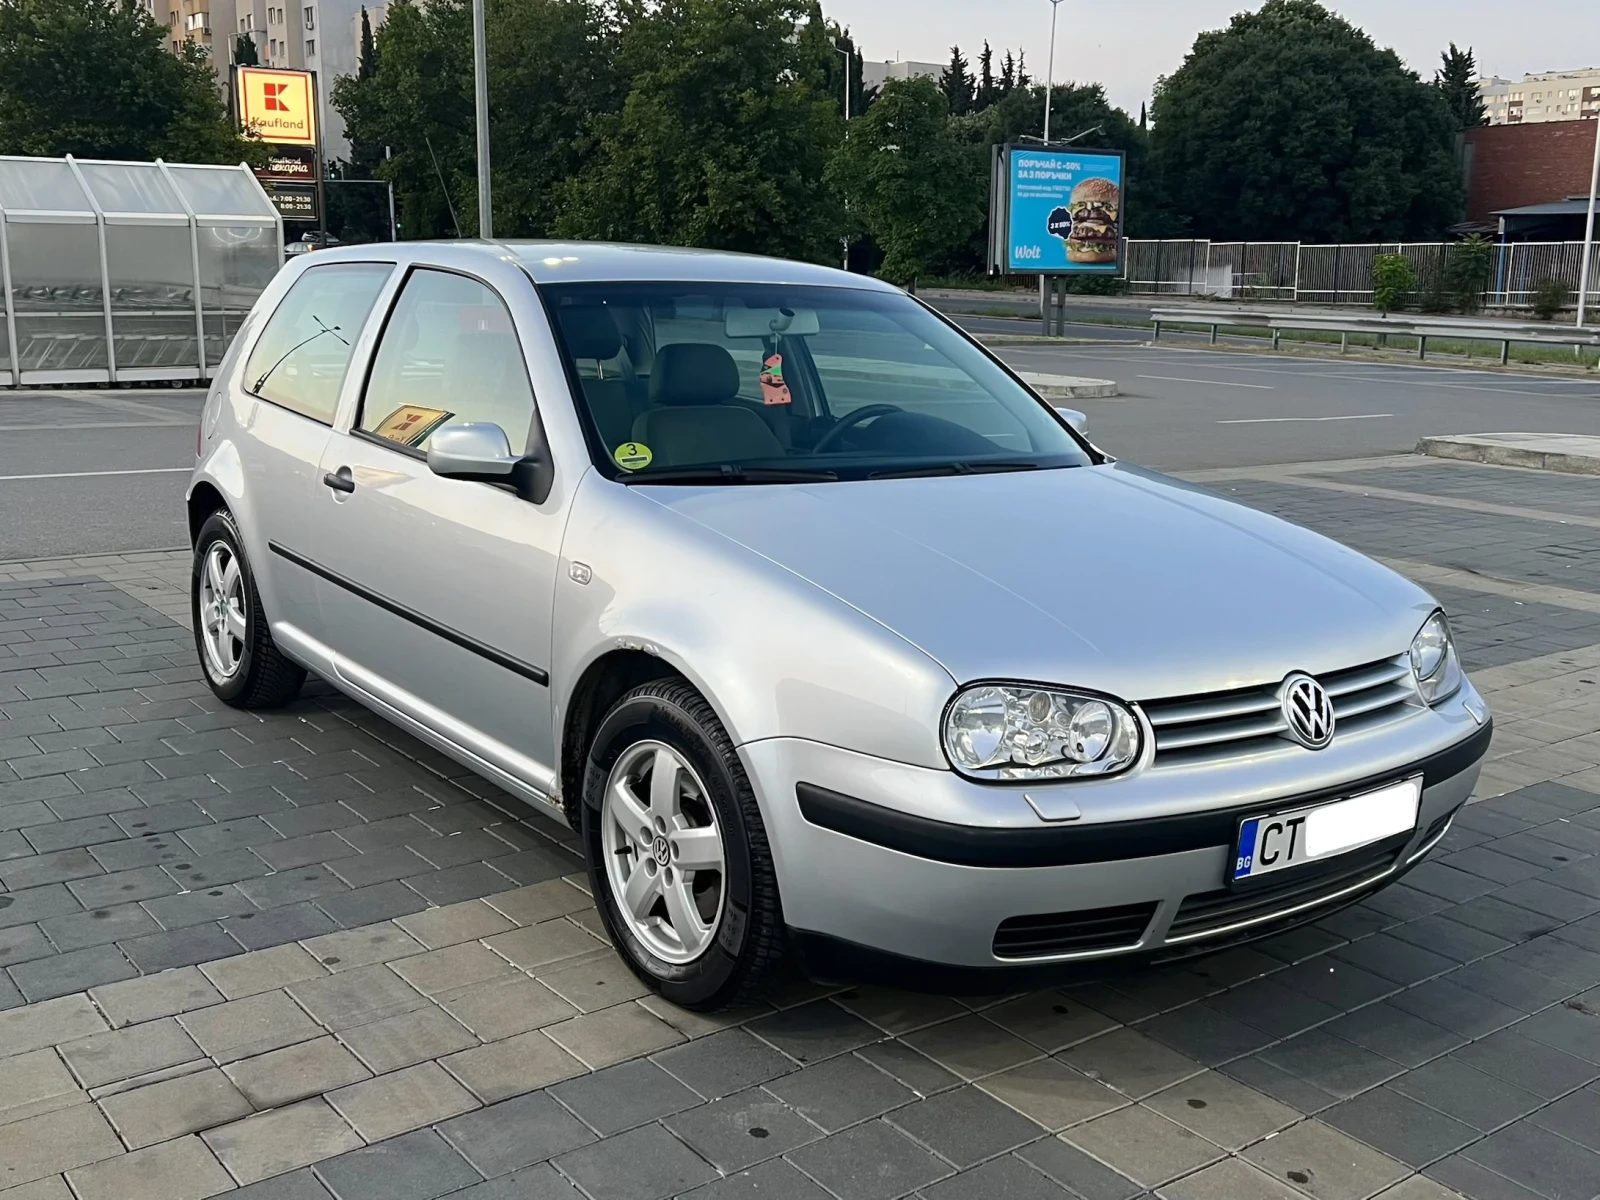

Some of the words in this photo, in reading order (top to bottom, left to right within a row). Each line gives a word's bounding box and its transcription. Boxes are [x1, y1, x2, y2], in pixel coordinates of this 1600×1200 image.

[252, 116, 304, 129] Kaufland
[268, 156, 302, 165] Kaufland
[1018, 158, 1056, 169] ПОРЪЧАЙ
[1017, 170, 1029, 179] ЗА
[1035, 171, 1072, 180] ПОРЪЧКИ
[1015, 245, 1041, 259] Wolt
[626, 443, 638, 456] 3
[1260, 816, 1306, 866] CT
[1236, 855, 1252, 871] BG
